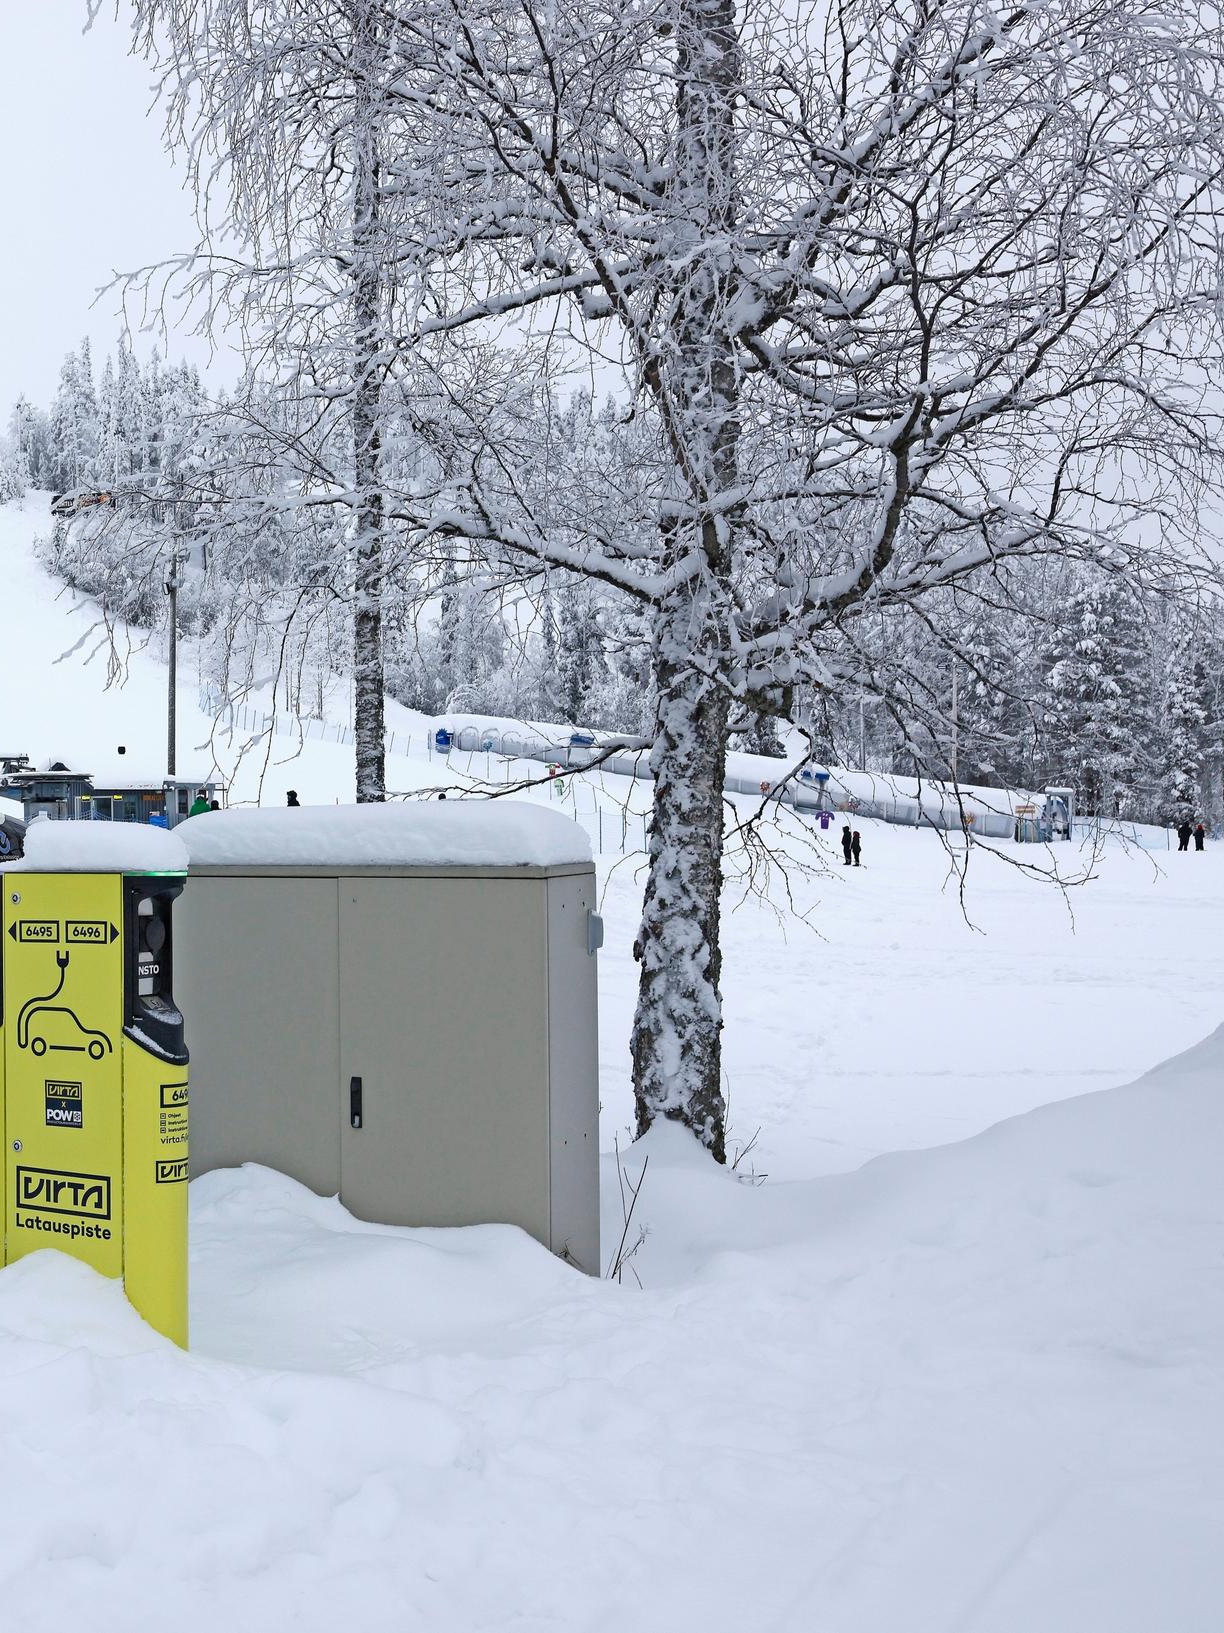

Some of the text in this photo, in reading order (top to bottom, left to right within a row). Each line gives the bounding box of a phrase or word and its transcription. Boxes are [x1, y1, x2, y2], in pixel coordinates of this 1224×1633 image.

[26, 926, 52, 937] 6495
[72, 926, 101, 938] 6496
[138, 964, 160, 976] NSTO
[47, 1109, 72, 1121] POW
[23, 1176, 104, 1210] VIRTA
[16, 1213, 111, 1239] Latauspiste
